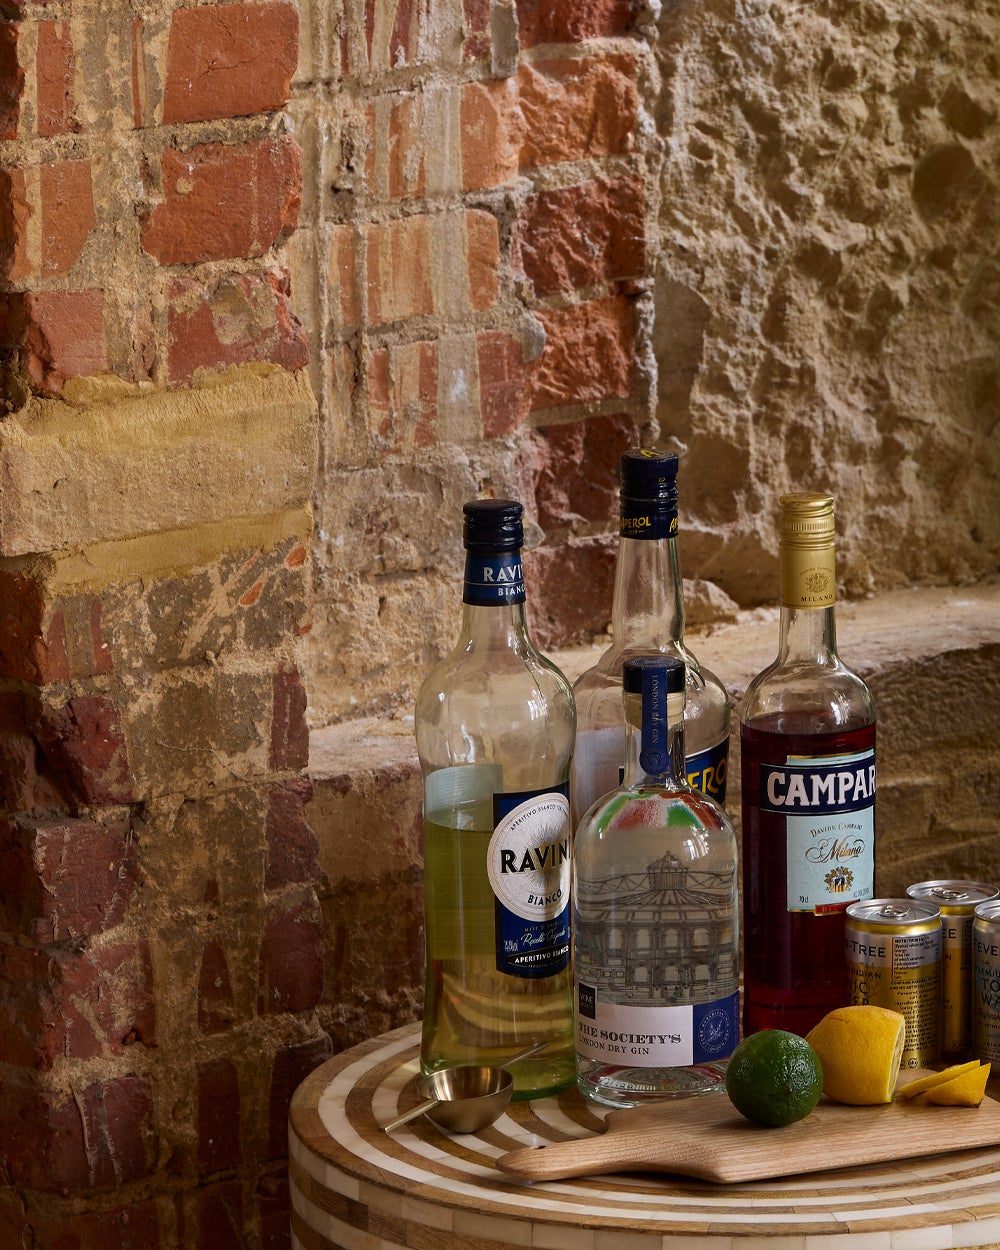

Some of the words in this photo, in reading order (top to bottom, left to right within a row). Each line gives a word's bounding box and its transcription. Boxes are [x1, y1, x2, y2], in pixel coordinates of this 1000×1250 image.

[620, 516, 651, 530] APEROL
[800, 593, 833, 602] MILANO
[651, 674, 660, 713] LONDON
[651, 729, 660, 744] GIN
[509, 809, 537, 832] APERITIVO
[527, 889, 562, 906] BIANCO
[514, 952, 551, 964] APERITIVO
[578, 1021, 598, 1037] THE
[600, 1029, 682, 1045] SOCIETY'S
[578, 1035, 605, 1050] LONDON
[607, 1044, 627, 1054] DRY
[630, 1047, 650, 1055] GIN
